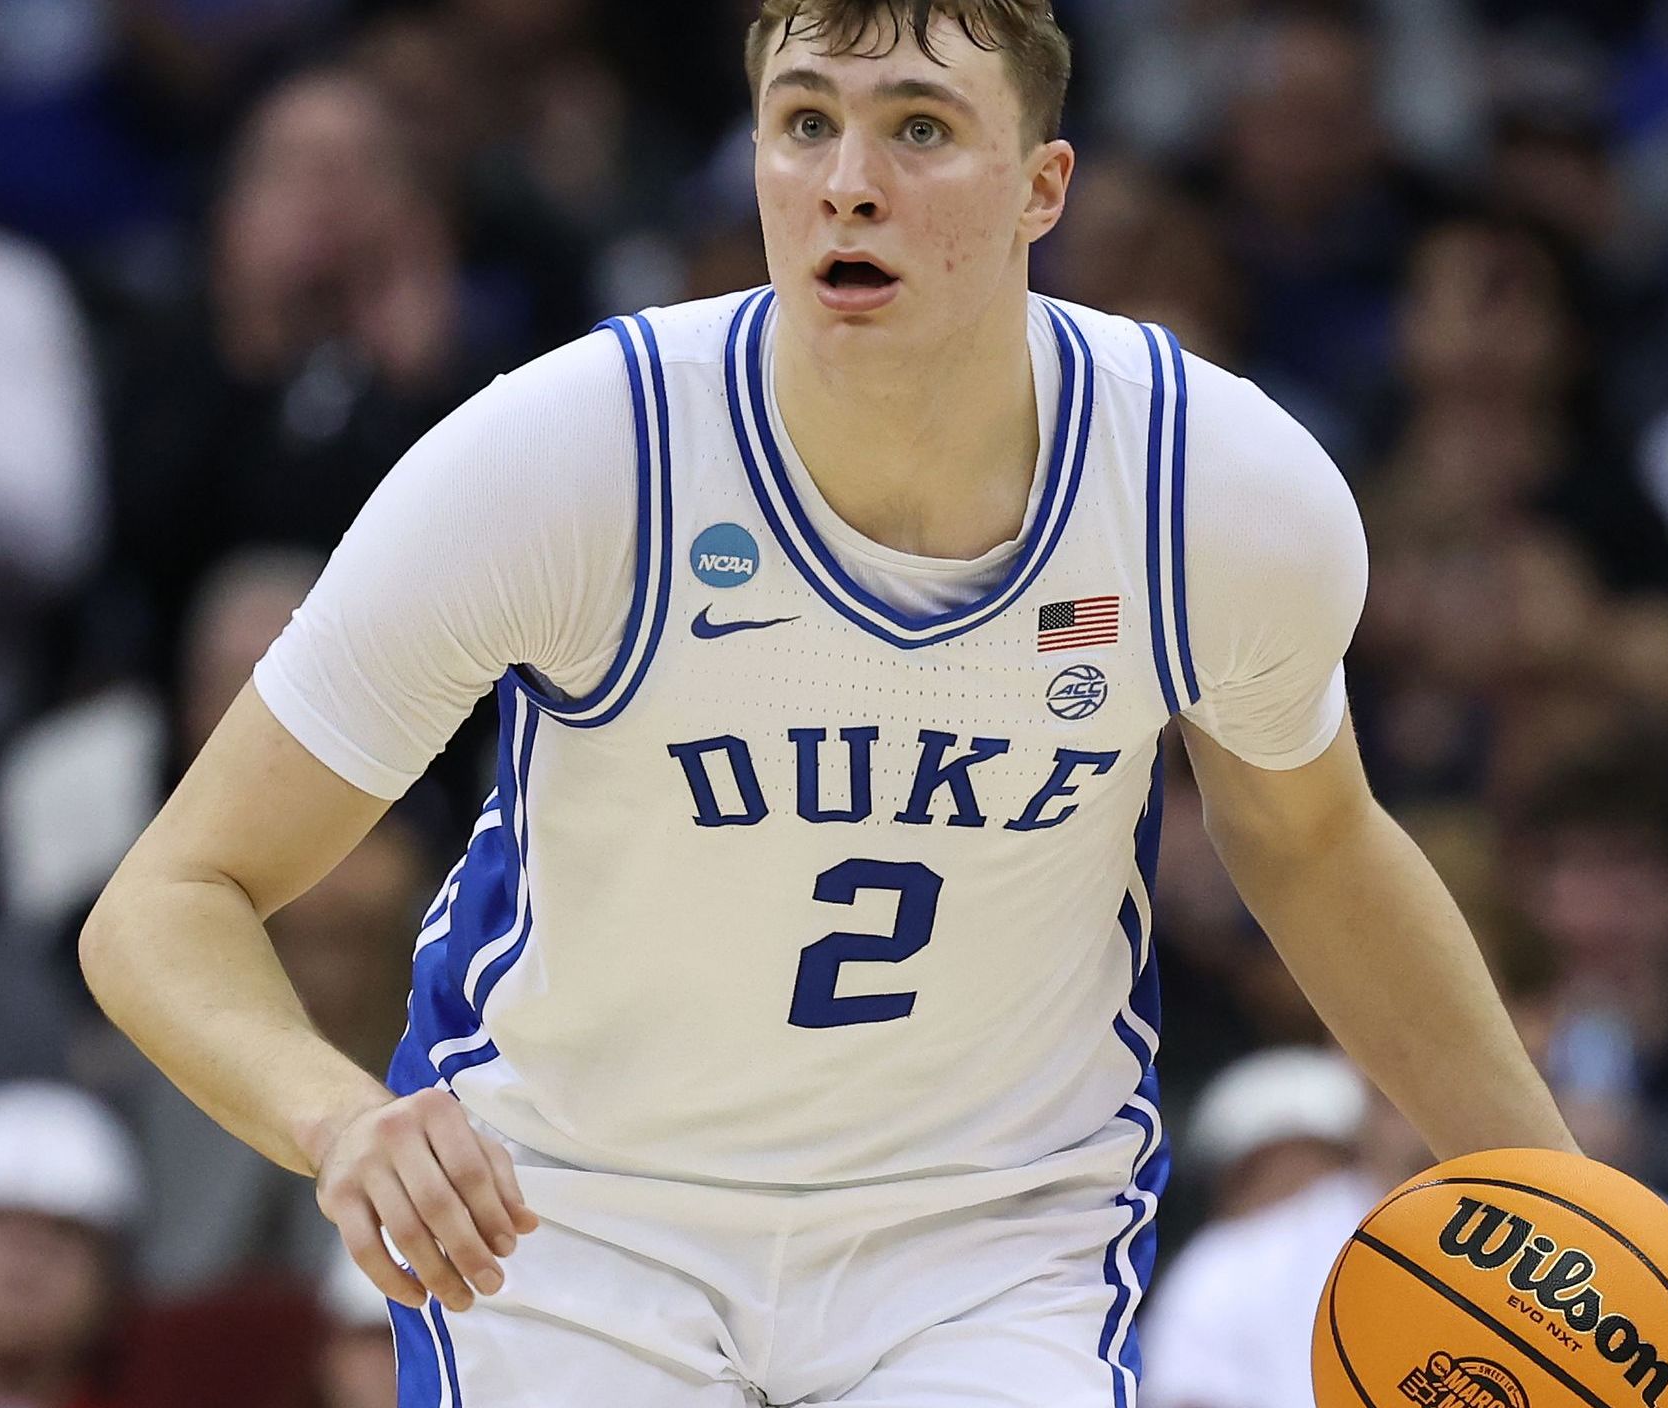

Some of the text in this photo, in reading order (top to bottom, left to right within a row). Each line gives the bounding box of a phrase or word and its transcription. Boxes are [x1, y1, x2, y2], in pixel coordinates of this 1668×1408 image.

[698, 553, 753, 576] NCAA
[1053, 680, 1106, 696] ACC
[667, 725, 1120, 832] DUKE
[787, 858, 944, 1029] 2
[1506, 1294, 1583, 1353] EVO NXT
